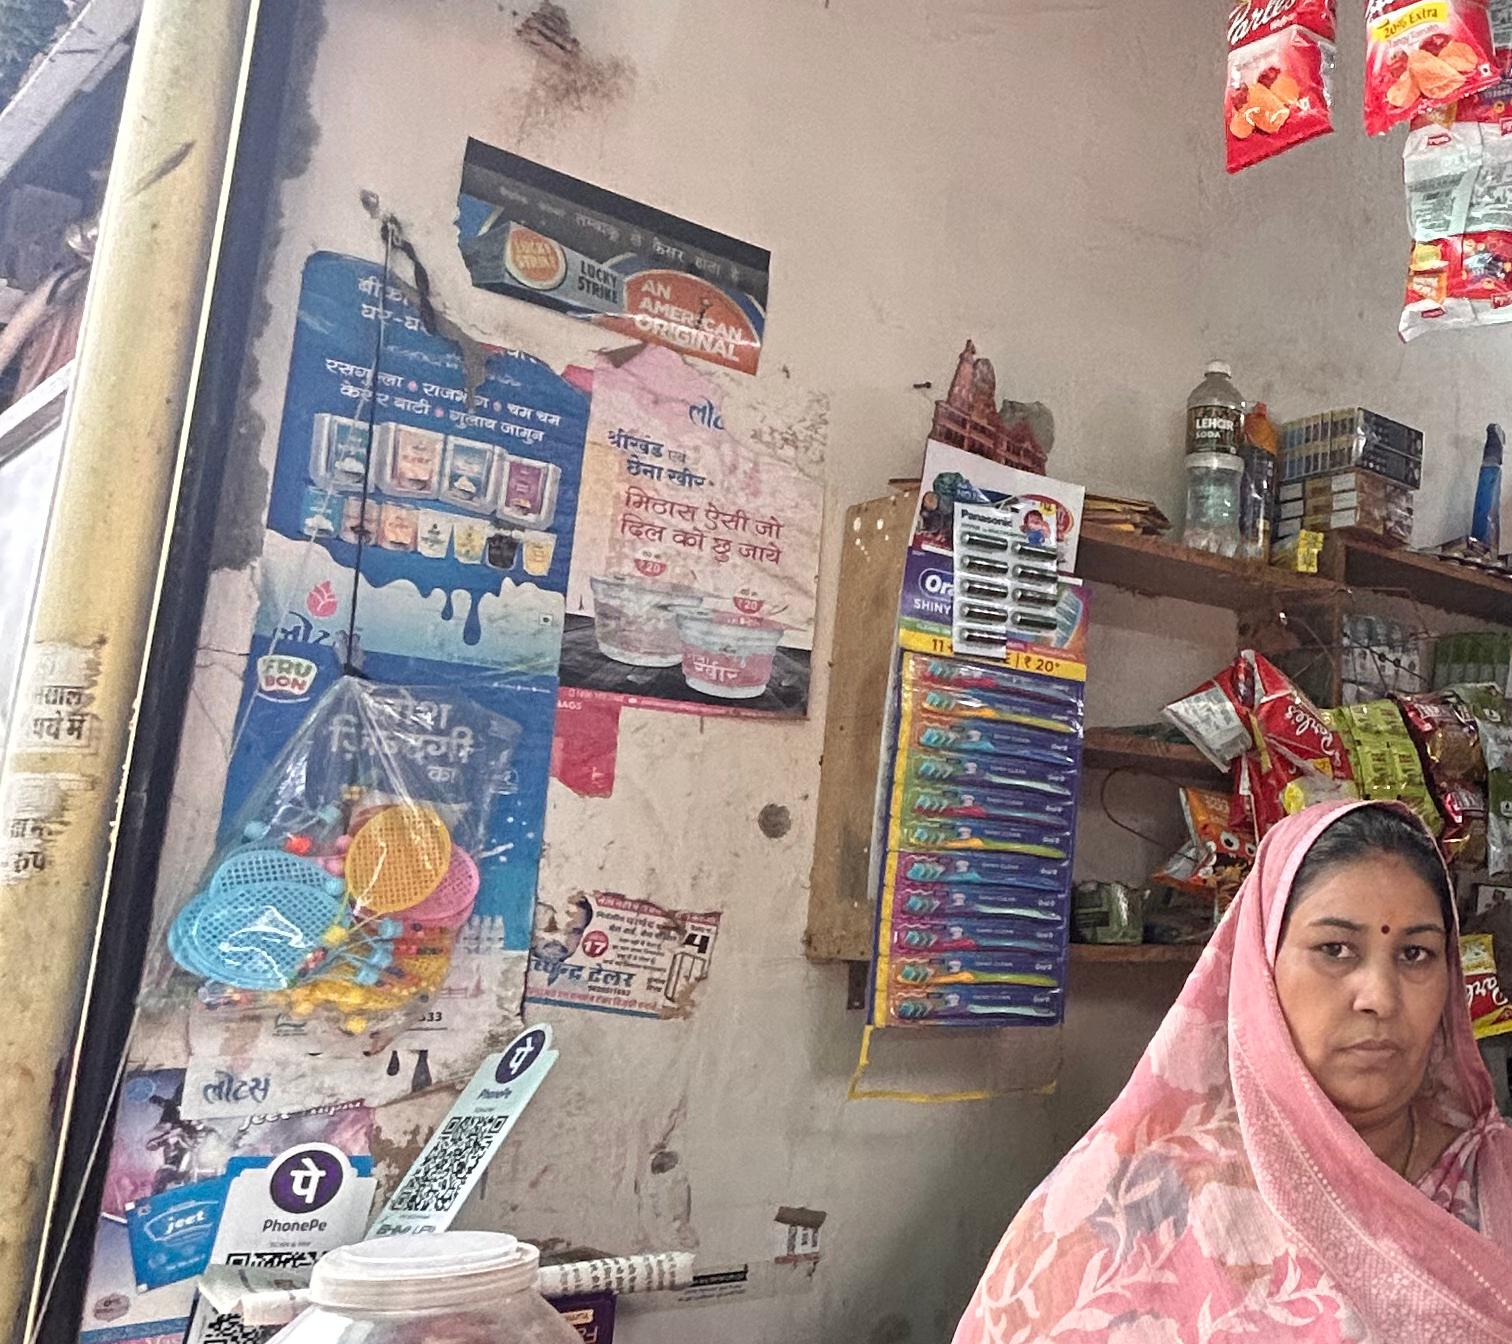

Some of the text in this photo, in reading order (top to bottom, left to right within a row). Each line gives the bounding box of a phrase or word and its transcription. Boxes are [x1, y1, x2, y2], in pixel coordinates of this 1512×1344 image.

[580, 259, 619, 290] LUCKY
[577, 278, 620, 307] STRIKE
[641, 279, 672, 301] AN
[638, 299, 744, 343] AMERICAN
[634, 318, 741, 363] ORIGINAL
[500, 422, 546, 446] जामुन
[1195, 430, 1222, 439] SODA
[624, 485, 784, 540] मिठास ऐसी जो
[960, 508, 1014, 529] Panasonic
[620, 514, 663, 543] दिल
[672, 524, 706, 552] को
[738, 540, 782, 565] जाये
[913, 597, 952, 615] SHINY
[930, 638, 945, 651] 11
[261, 657, 314, 677] FRU
[263, 675, 308, 691] BON
[582, 939, 609, 955] 17
[587, 962, 637, 988] टेलर
[202, 1068, 271, 1105] लोटस
[289, 1157, 328, 1205] पे
[164, 1210, 207, 1235] jeet
[261, 1217, 329, 1236] PhonePe
